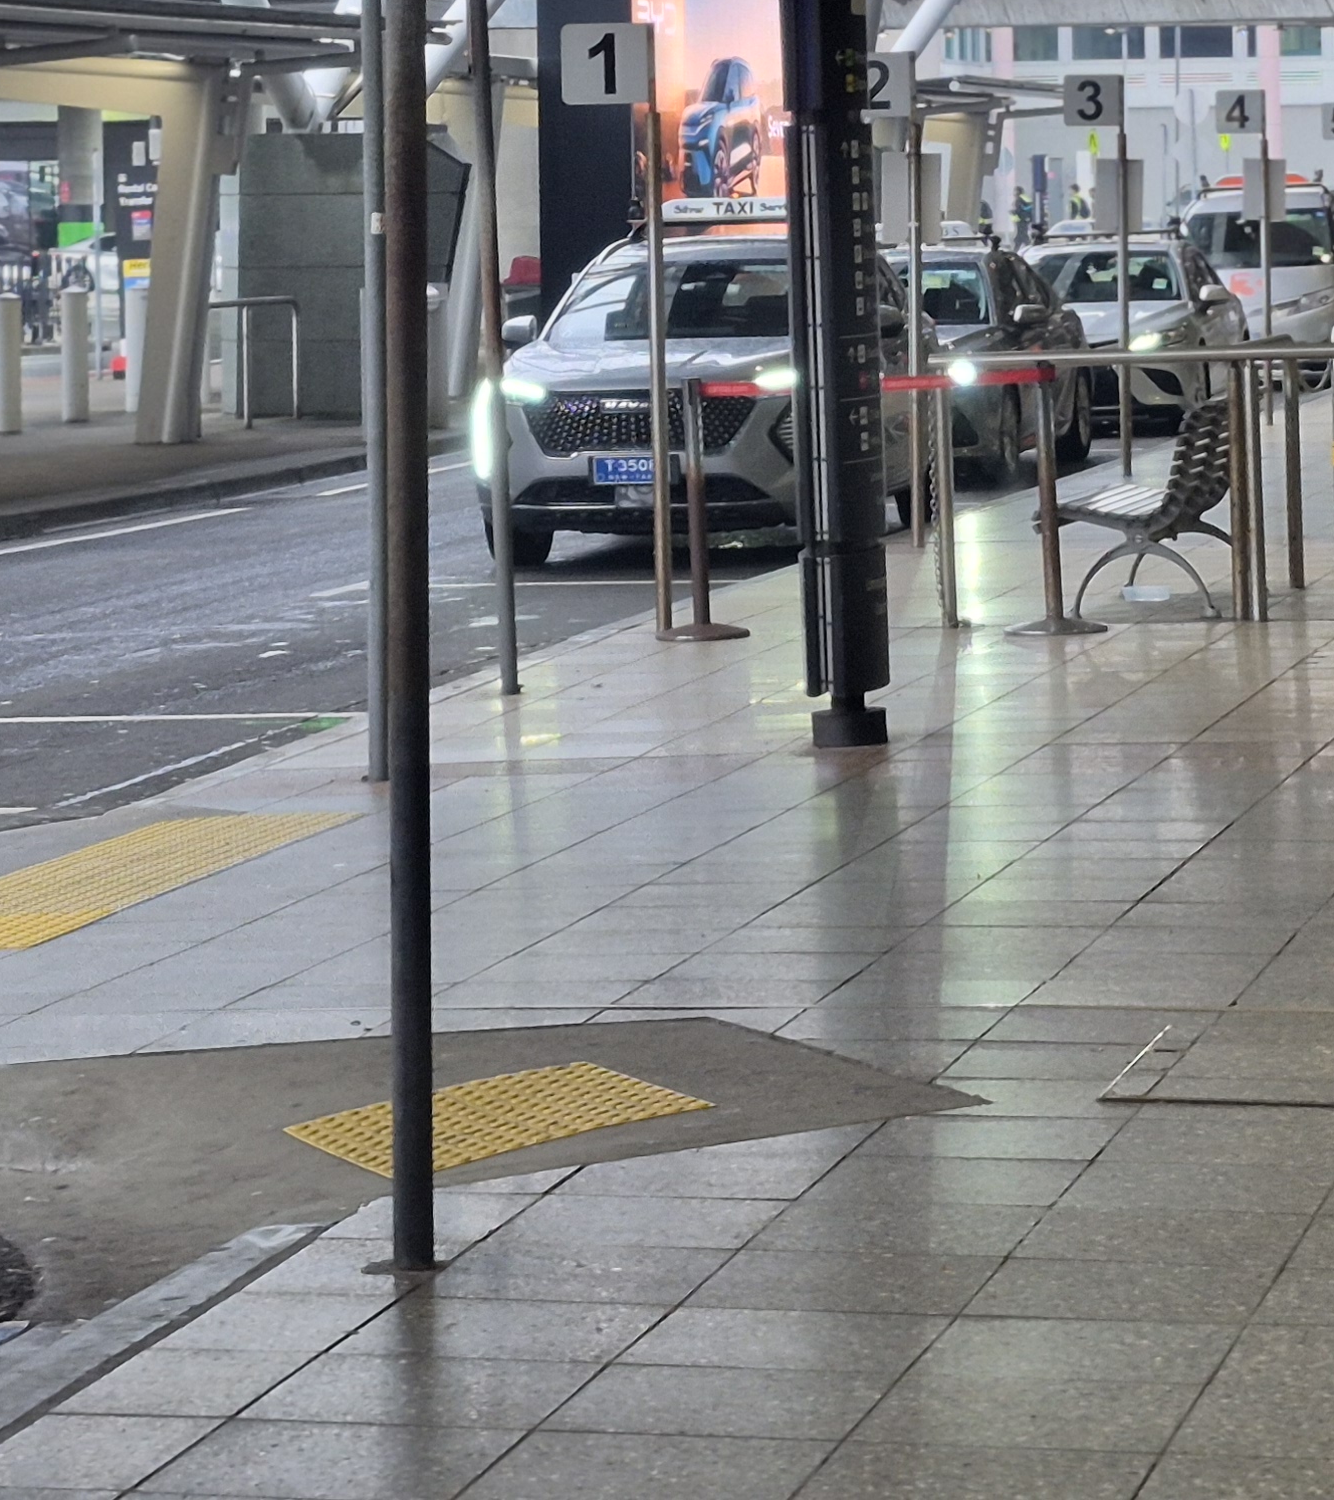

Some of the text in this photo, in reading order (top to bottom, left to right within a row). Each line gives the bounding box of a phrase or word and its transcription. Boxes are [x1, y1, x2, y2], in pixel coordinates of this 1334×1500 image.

[587, 32, 617, 95] 1
[866, 59, 891, 110] 2
[1076, 80, 1104, 122] 3
[1224, 94, 1250, 129] 4
[712, 201, 754, 216] TAXI
